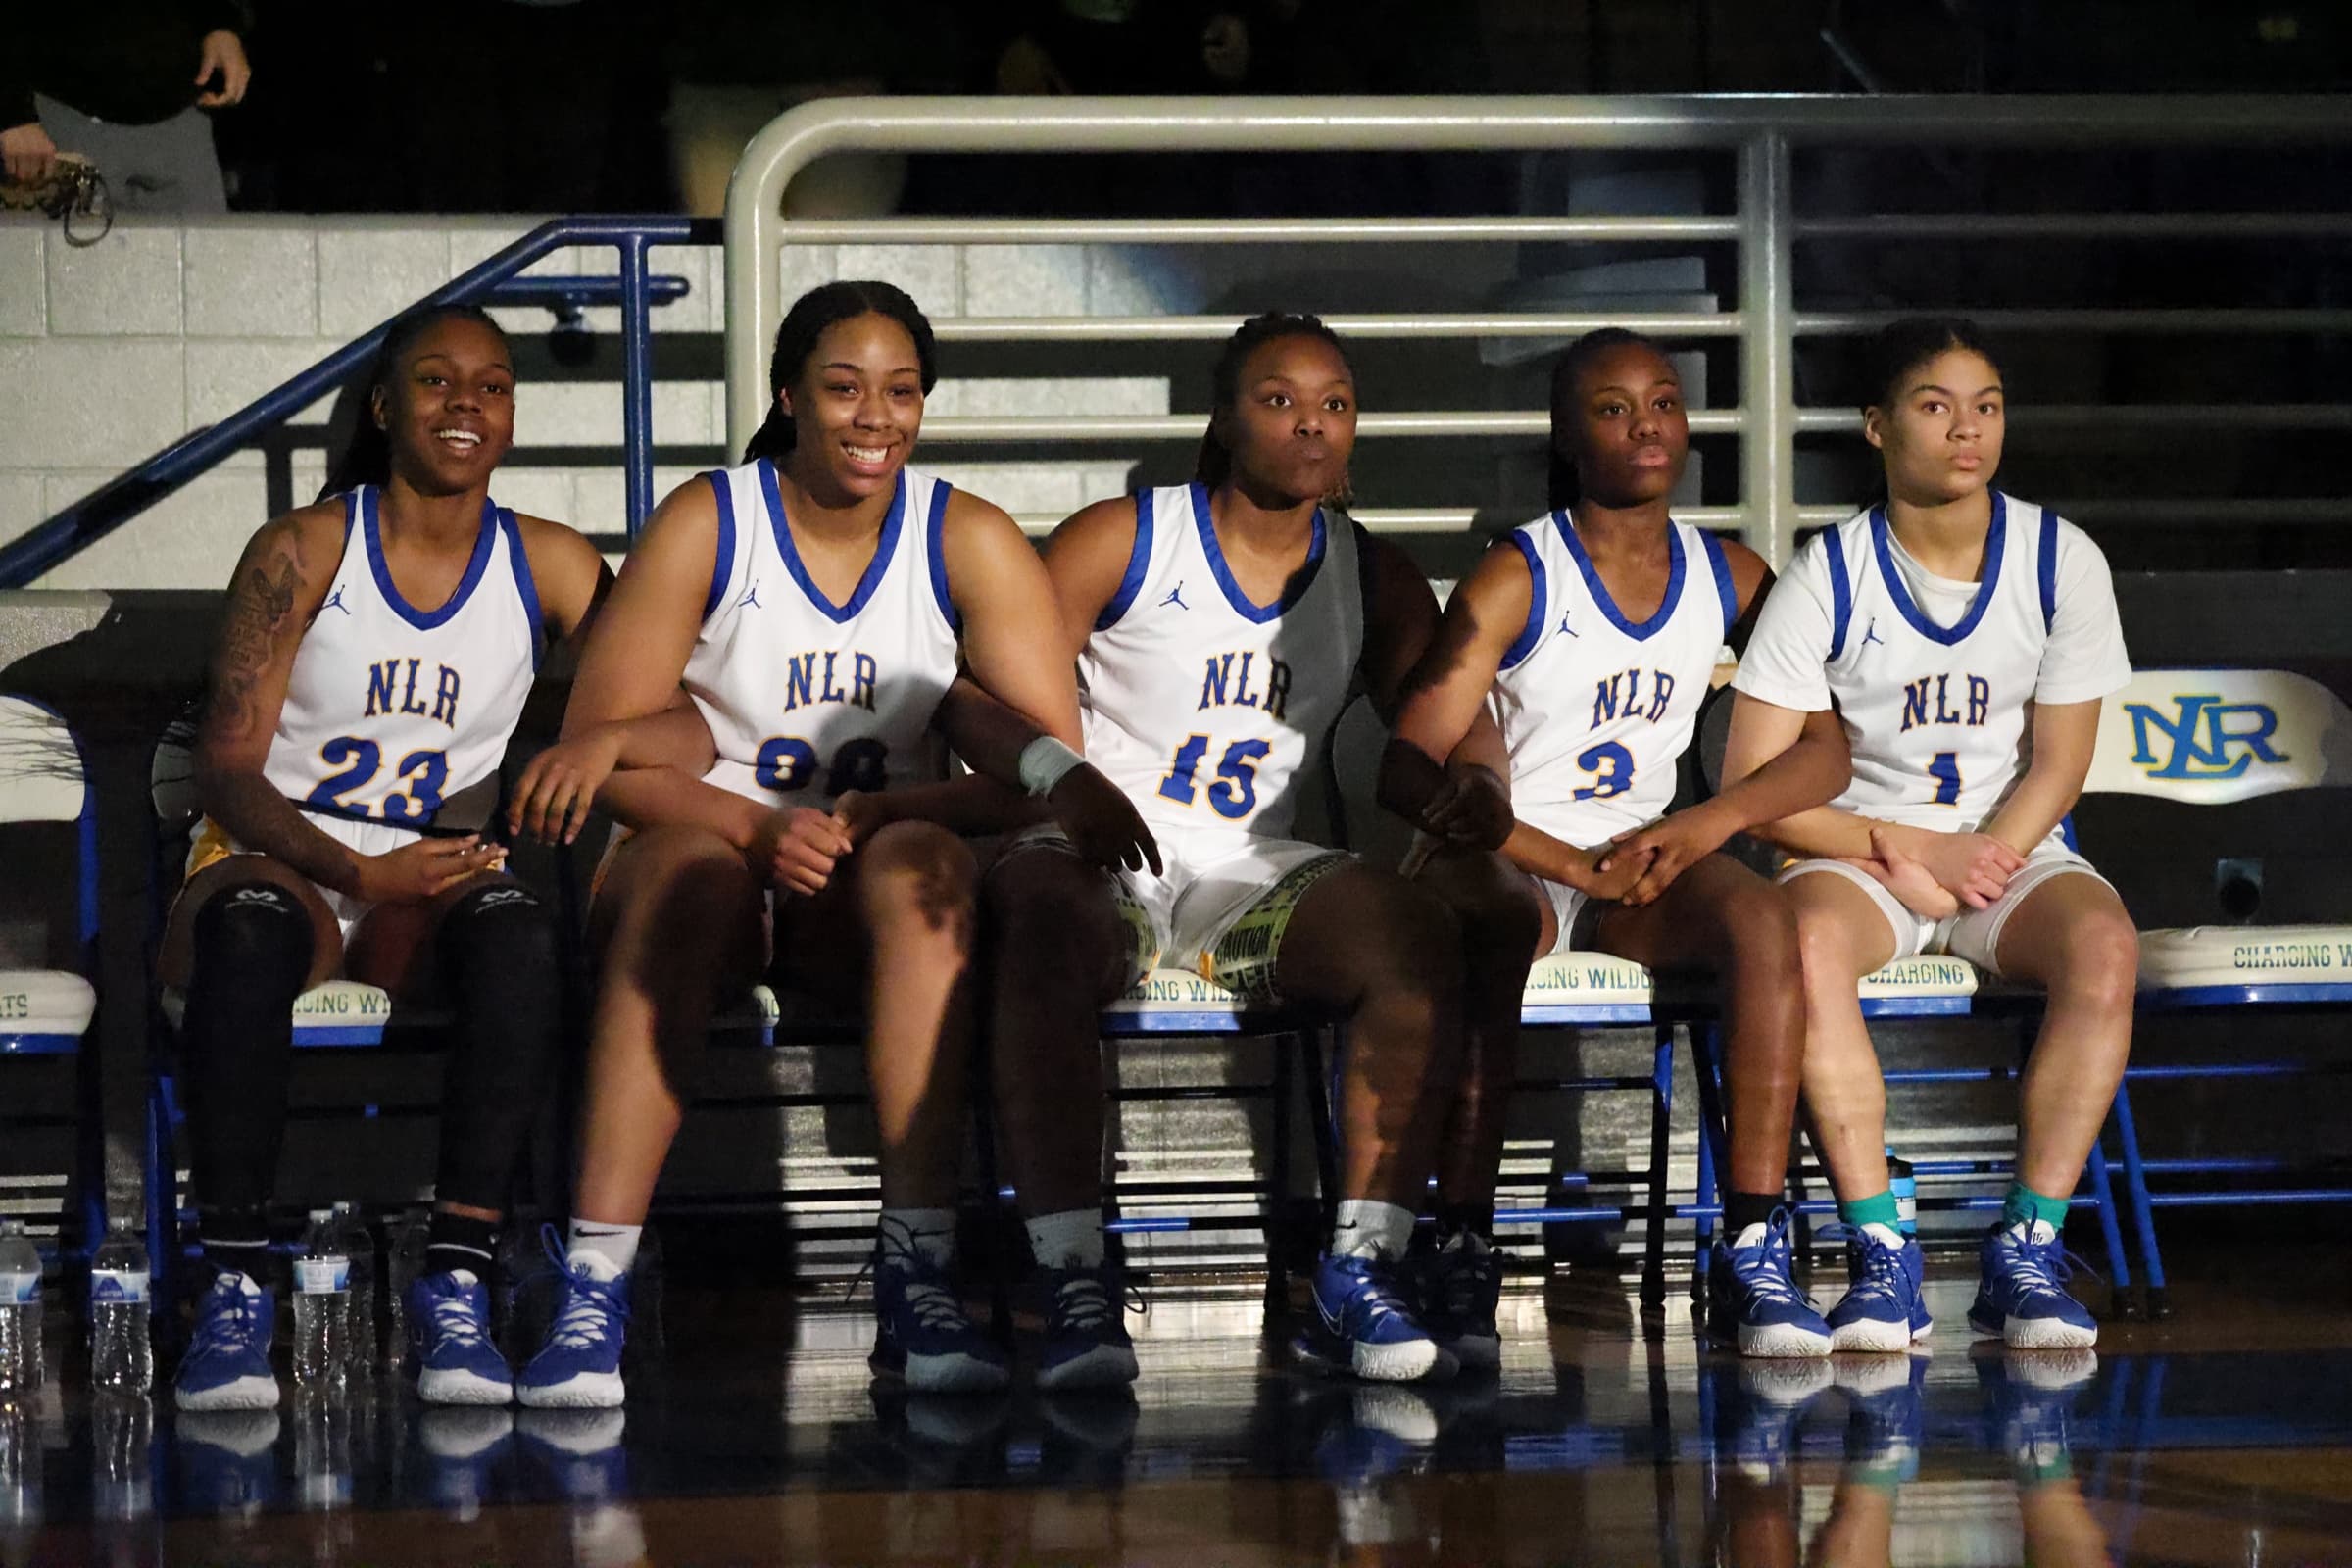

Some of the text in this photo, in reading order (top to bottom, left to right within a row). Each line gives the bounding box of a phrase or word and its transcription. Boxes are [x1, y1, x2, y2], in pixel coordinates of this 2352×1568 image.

[364, 657, 461, 730] NLR
[783, 649, 878, 715] NLR
[1197, 650, 1292, 722] NLR
[1589, 667, 1676, 732] NLR
[1898, 671, 1990, 734] NLR
[304, 734, 452, 826] 23
[1154, 732, 1273, 822] 15
[1570, 738, 1637, 801] 3
[1925, 751, 1965, 809] 1
[2234, 945, 2331, 968] CHARGING
[0, 993, 28, 1017] TS
